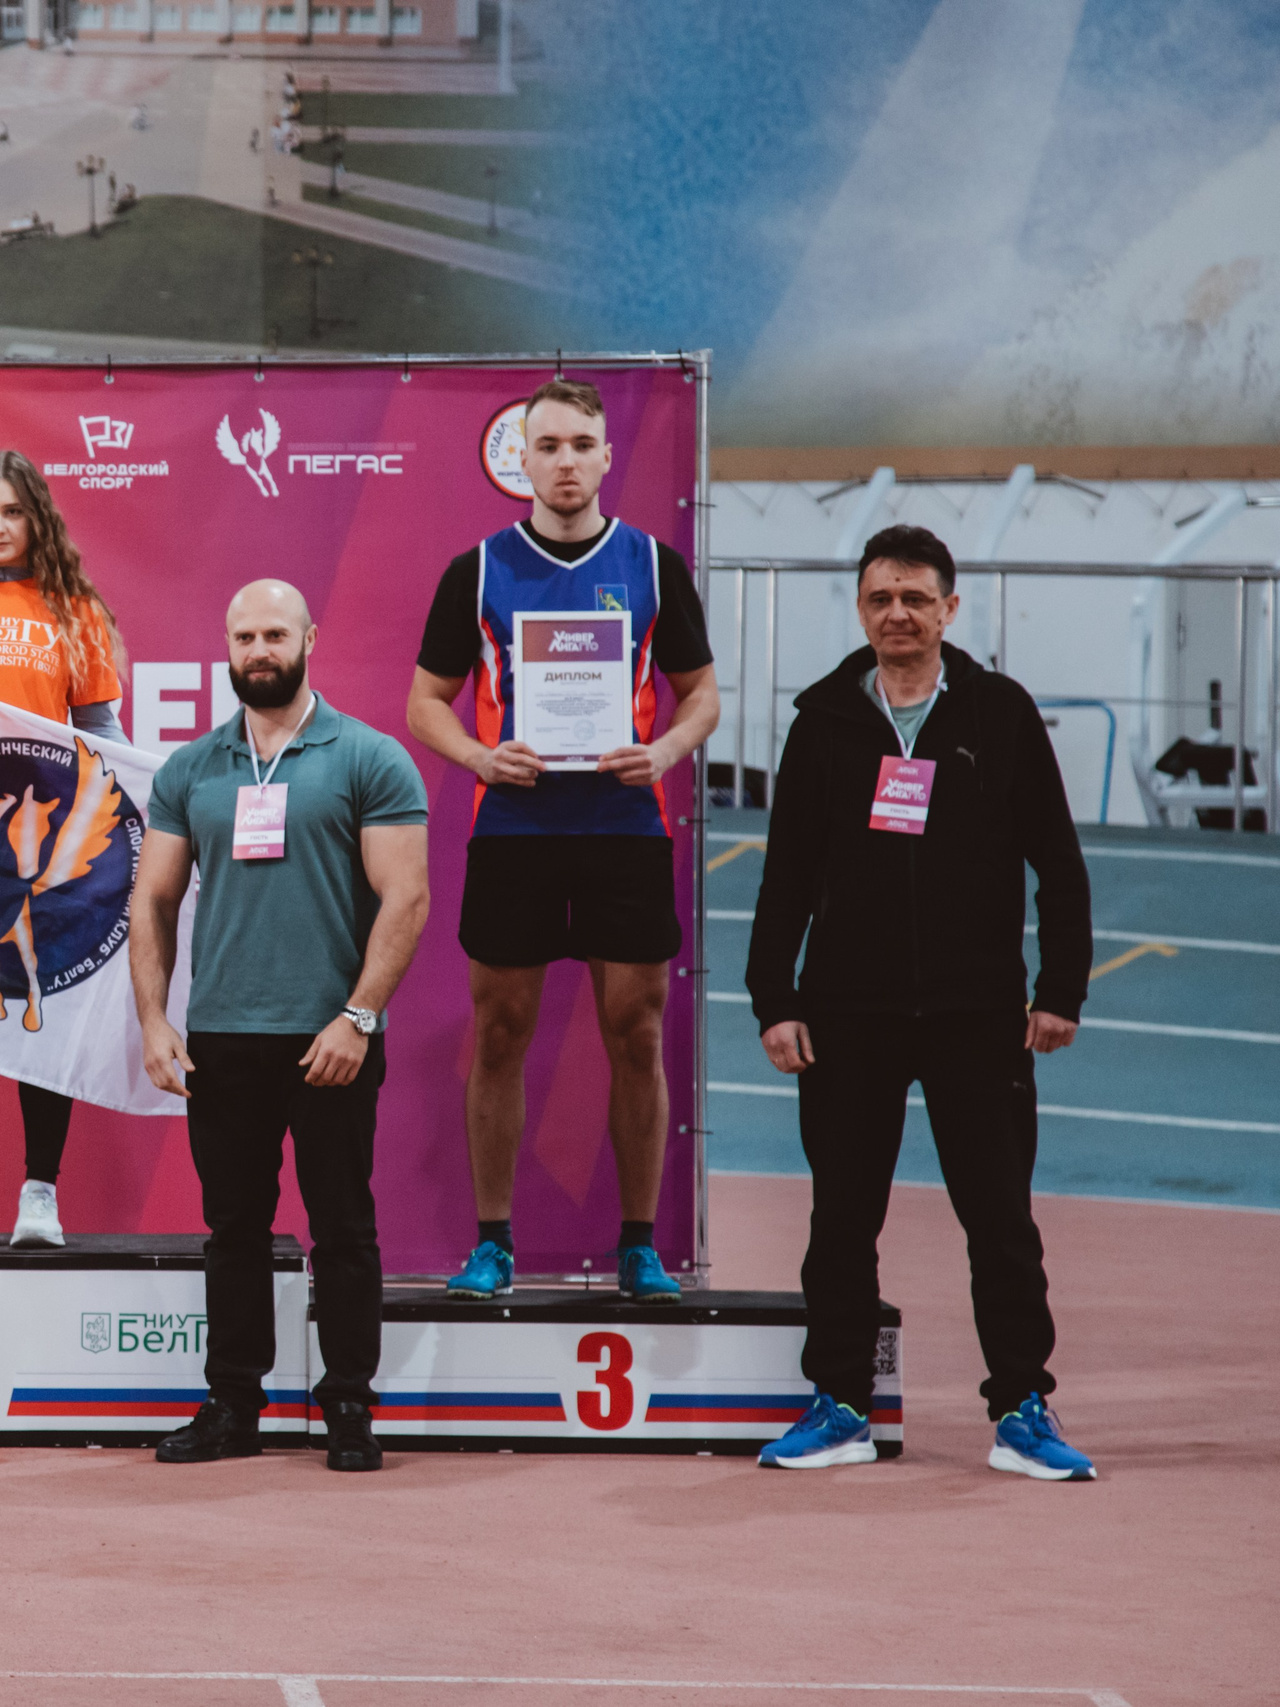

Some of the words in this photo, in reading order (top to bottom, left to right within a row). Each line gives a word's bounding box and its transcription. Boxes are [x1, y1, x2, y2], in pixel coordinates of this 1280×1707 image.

[44, 461, 169, 475] БЕЛГОРОДСКИЙ
[288, 455, 403, 474] ПЕГАС
[79, 477, 133, 489] СПОРТ
[30, 647, 60, 667] STATE
[33, 660, 57, 678] (BSU)
[544, 672, 602, 683] ДИПЛОМ
[99, 917, 130, 957] КЛУБ
[144, 1313, 188, 1328] НИУ
[118, 1319, 208, 1353] БелГ
[576, 1331, 634, 1431] 3
